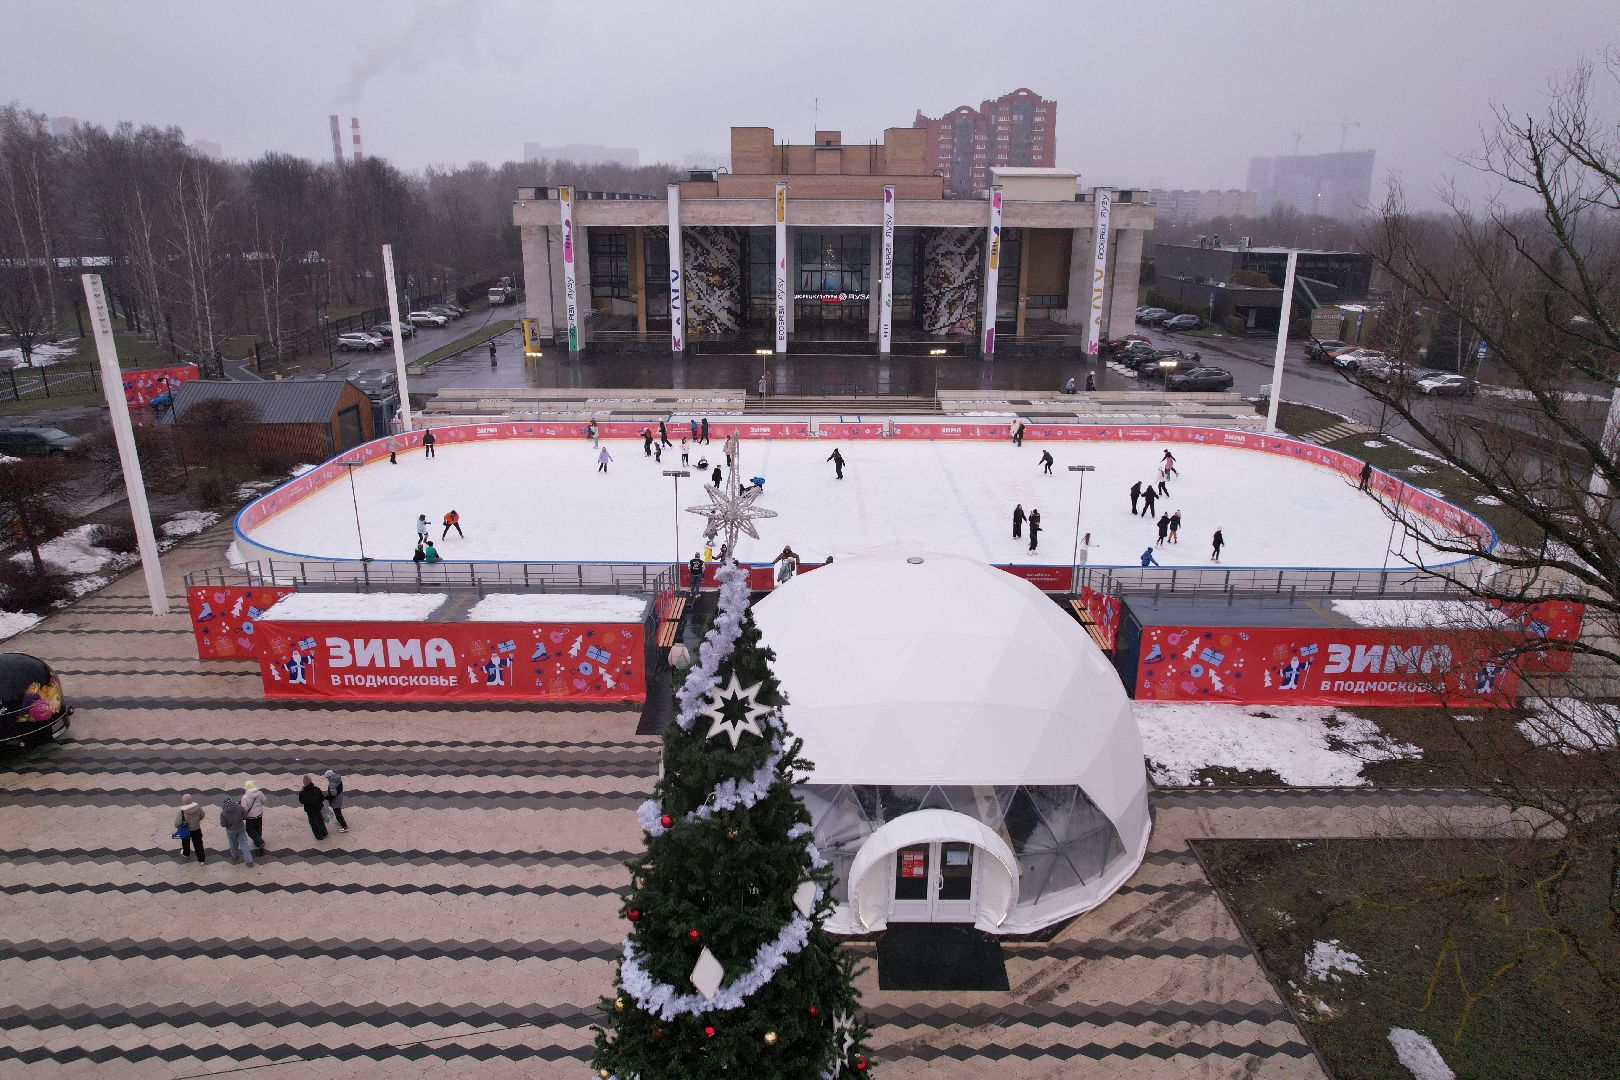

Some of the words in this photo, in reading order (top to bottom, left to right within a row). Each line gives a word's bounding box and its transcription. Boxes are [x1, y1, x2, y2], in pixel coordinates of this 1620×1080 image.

[325, 637, 457, 668] ЗИМА
[1323, 643, 1453, 674] ЗИМА
[330, 674, 342, 686] В
[343, 674, 459, 688] ПОДМОСКОВЬЕ
[1320, 680, 1331, 691] В
[1333, 680, 1447, 692] ПОДМОСКОВЕ
